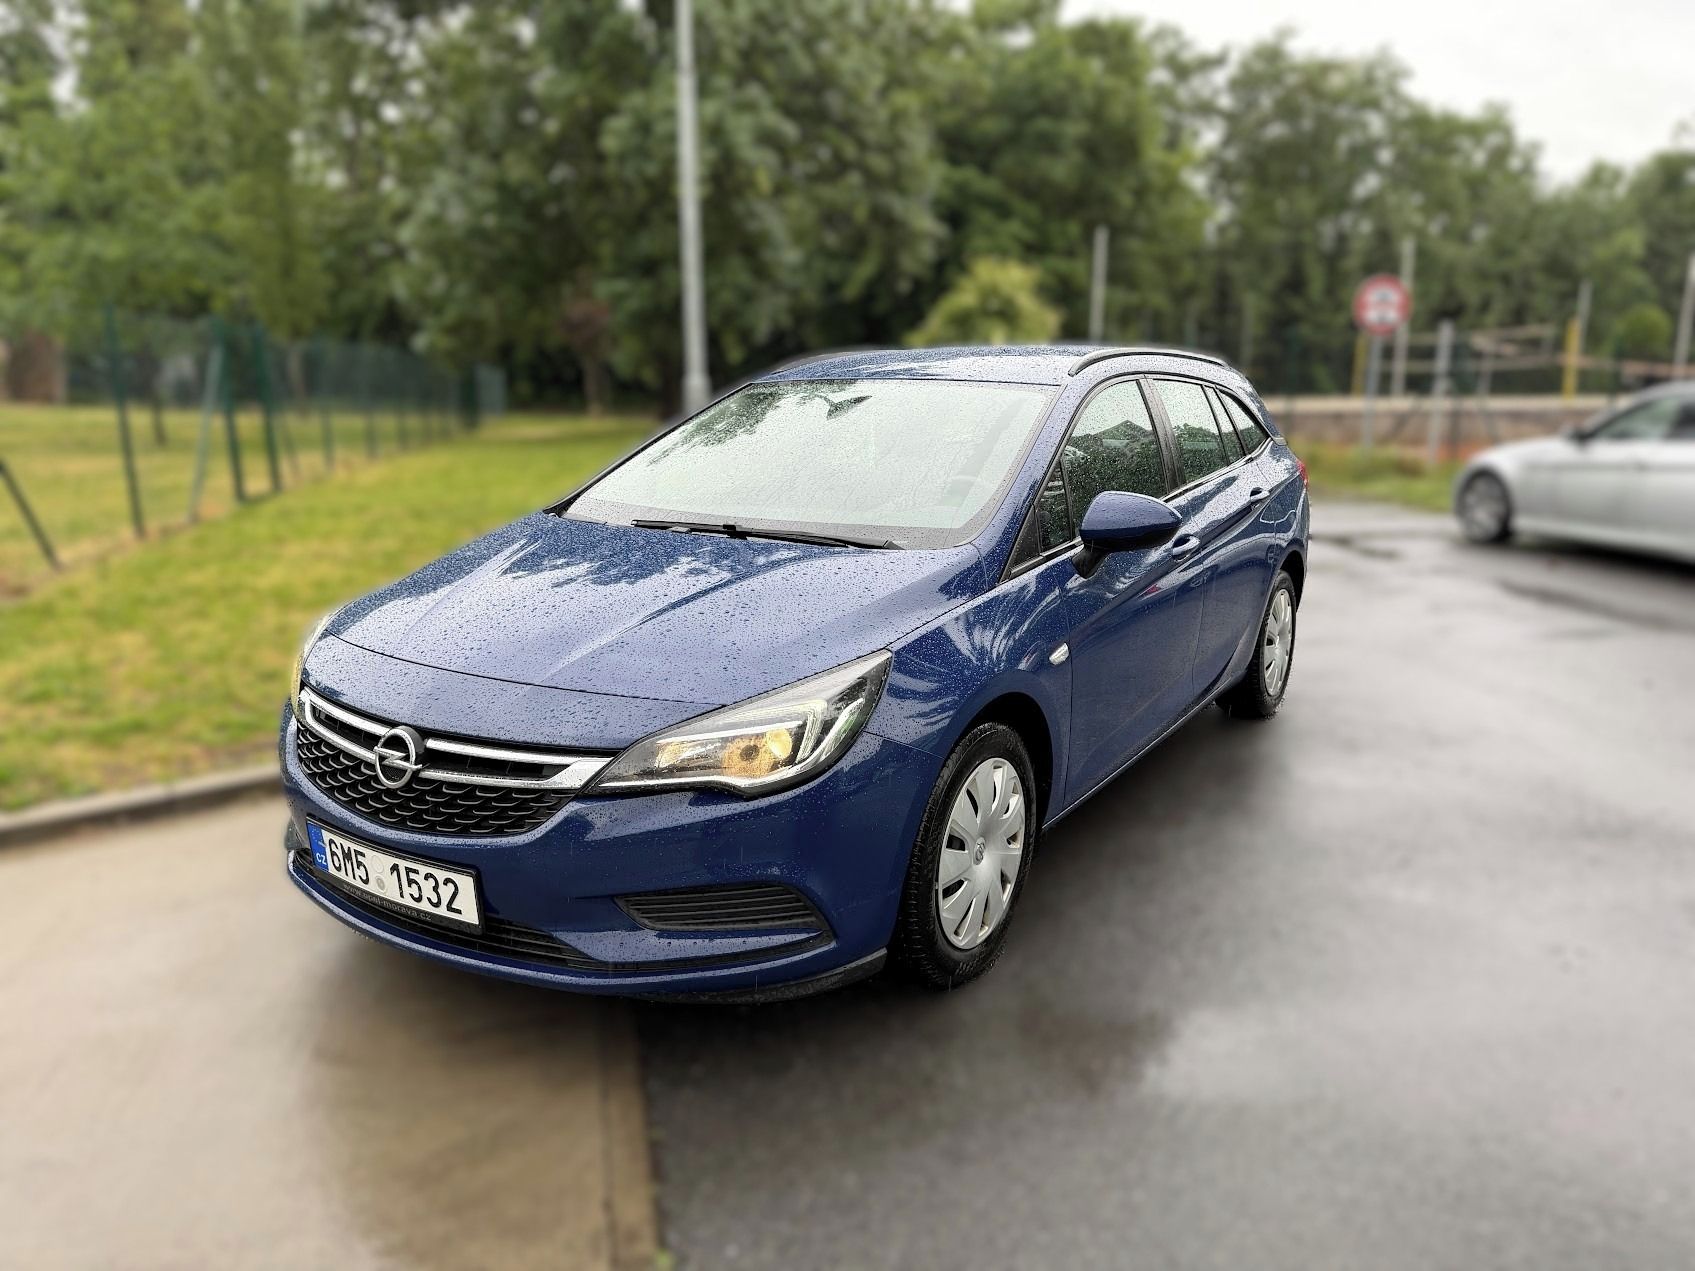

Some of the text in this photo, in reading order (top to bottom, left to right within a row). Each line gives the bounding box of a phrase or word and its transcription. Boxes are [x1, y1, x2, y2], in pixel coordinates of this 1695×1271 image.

[316, 852, 328, 865] CZ
[328, 838, 463, 915] 6M5 1532
